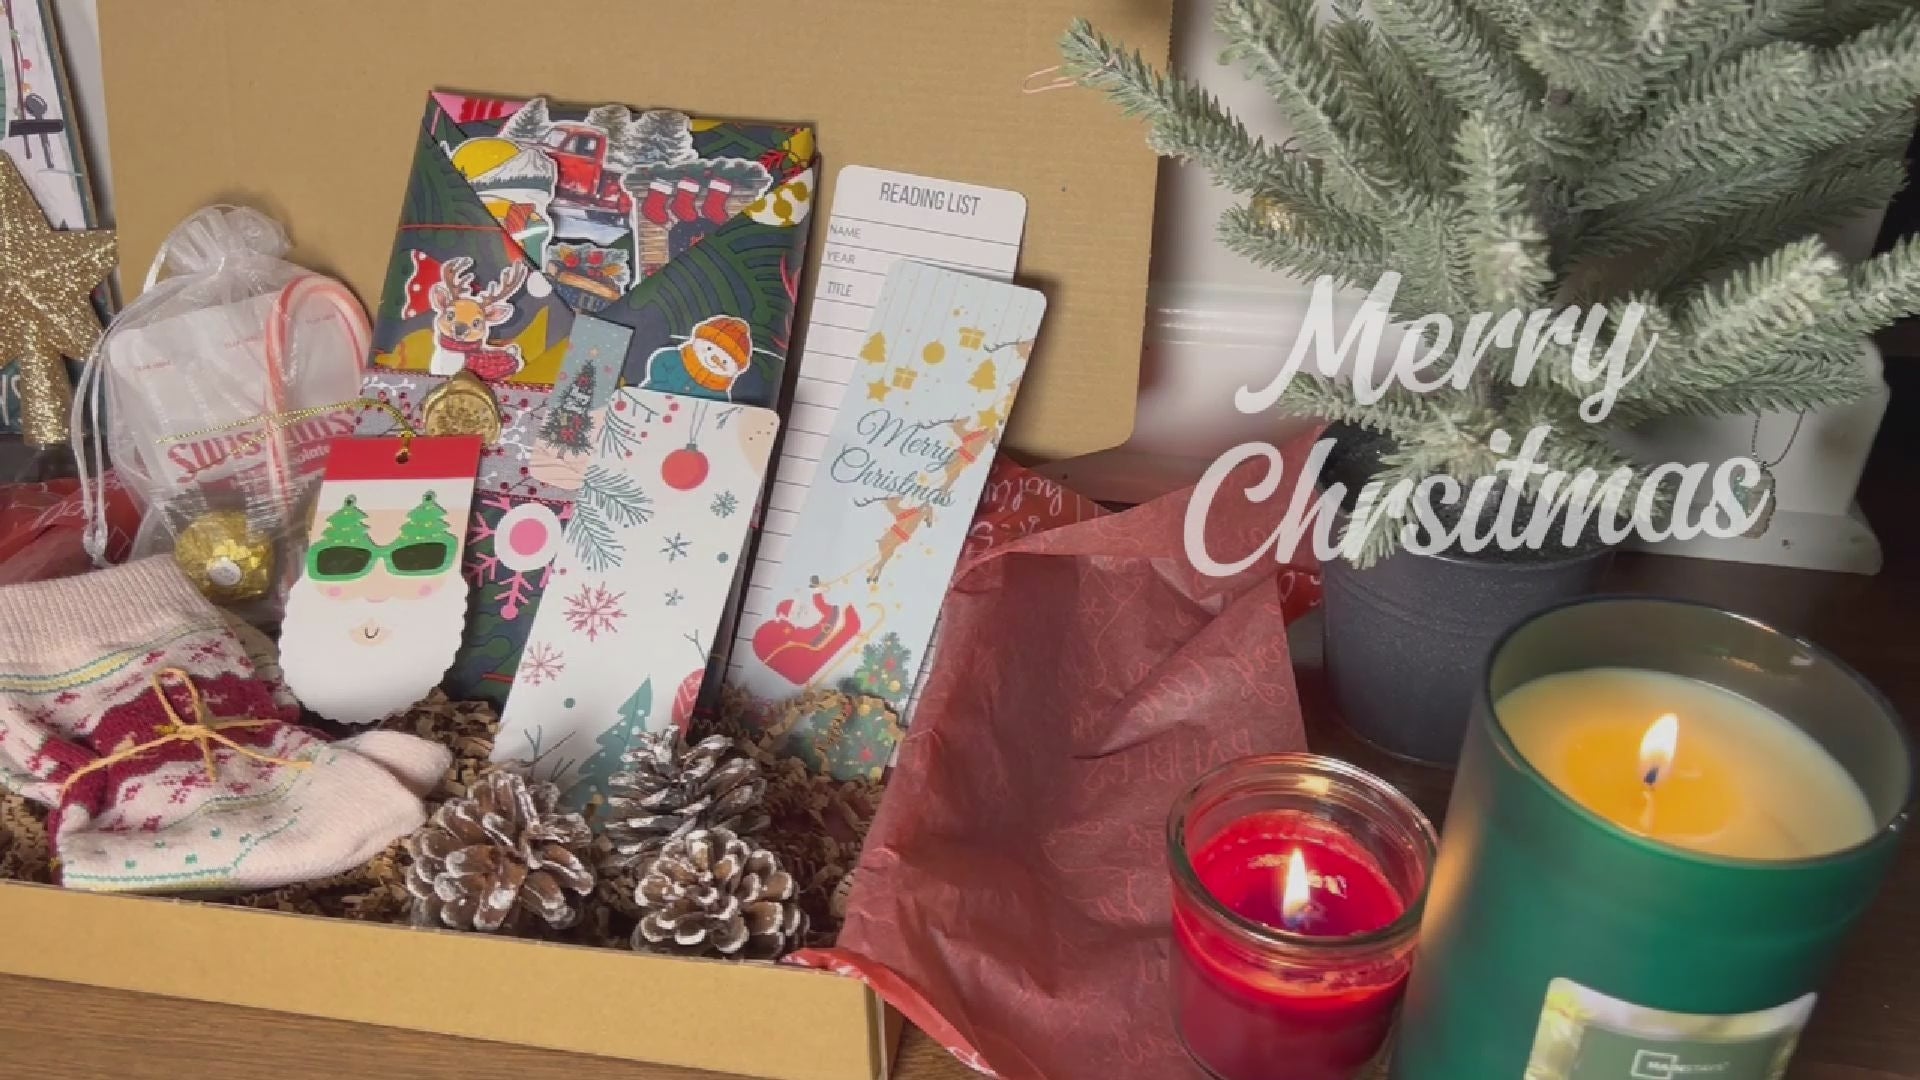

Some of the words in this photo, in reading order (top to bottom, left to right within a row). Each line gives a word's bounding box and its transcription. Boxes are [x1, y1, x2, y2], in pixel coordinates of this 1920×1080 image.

[879, 181, 945, 211] READING
[947, 191, 981, 216] LIST
[830, 223, 861, 240] NAME
[826, 250, 856, 265] YEAR
[827, 281, 854, 297] TITLE
[856, 407, 961, 473] Merry
[830, 444, 957, 508] Christmas
